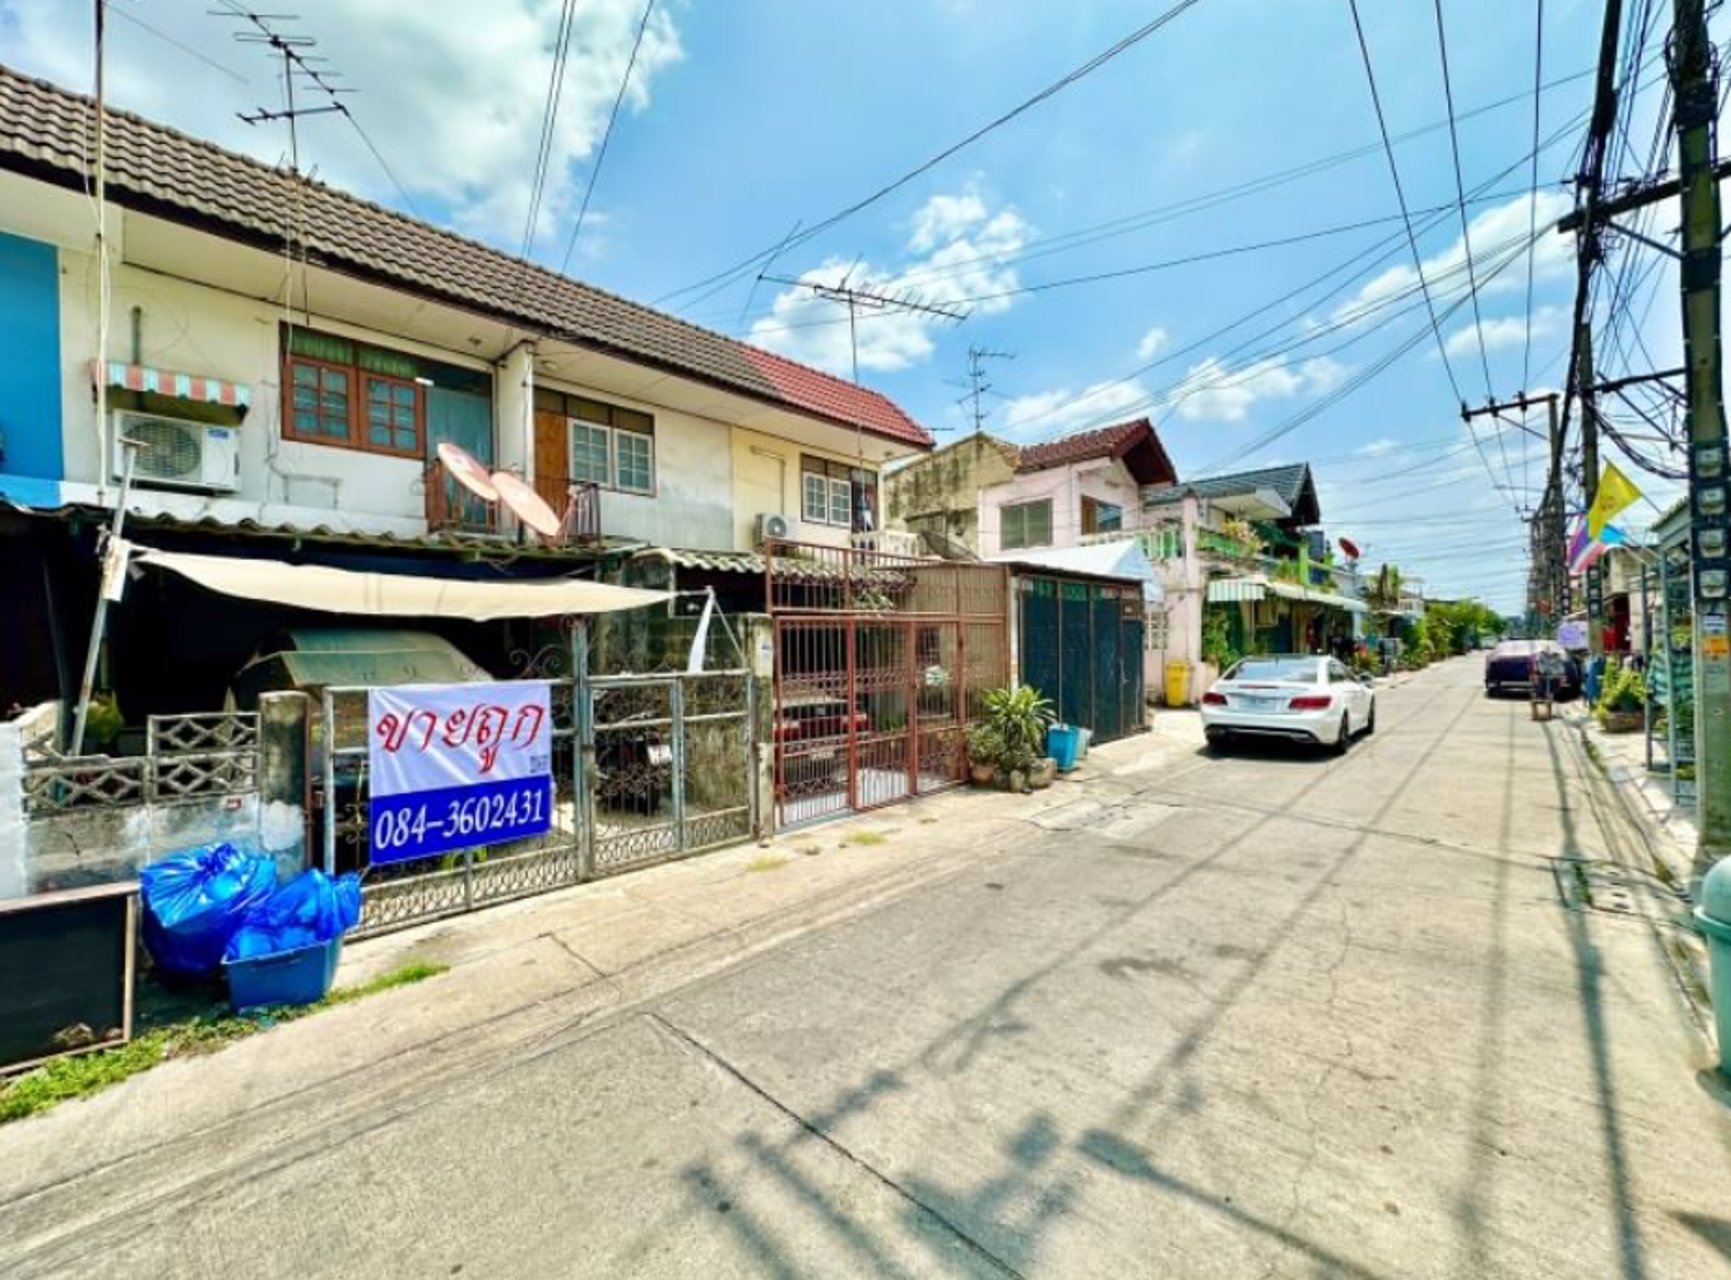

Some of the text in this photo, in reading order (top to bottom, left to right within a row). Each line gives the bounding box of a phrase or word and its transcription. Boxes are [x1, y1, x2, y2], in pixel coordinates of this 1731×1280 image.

[376, 704, 544, 774] ขายถูก
[375, 789, 544, 849] 084-3602431
